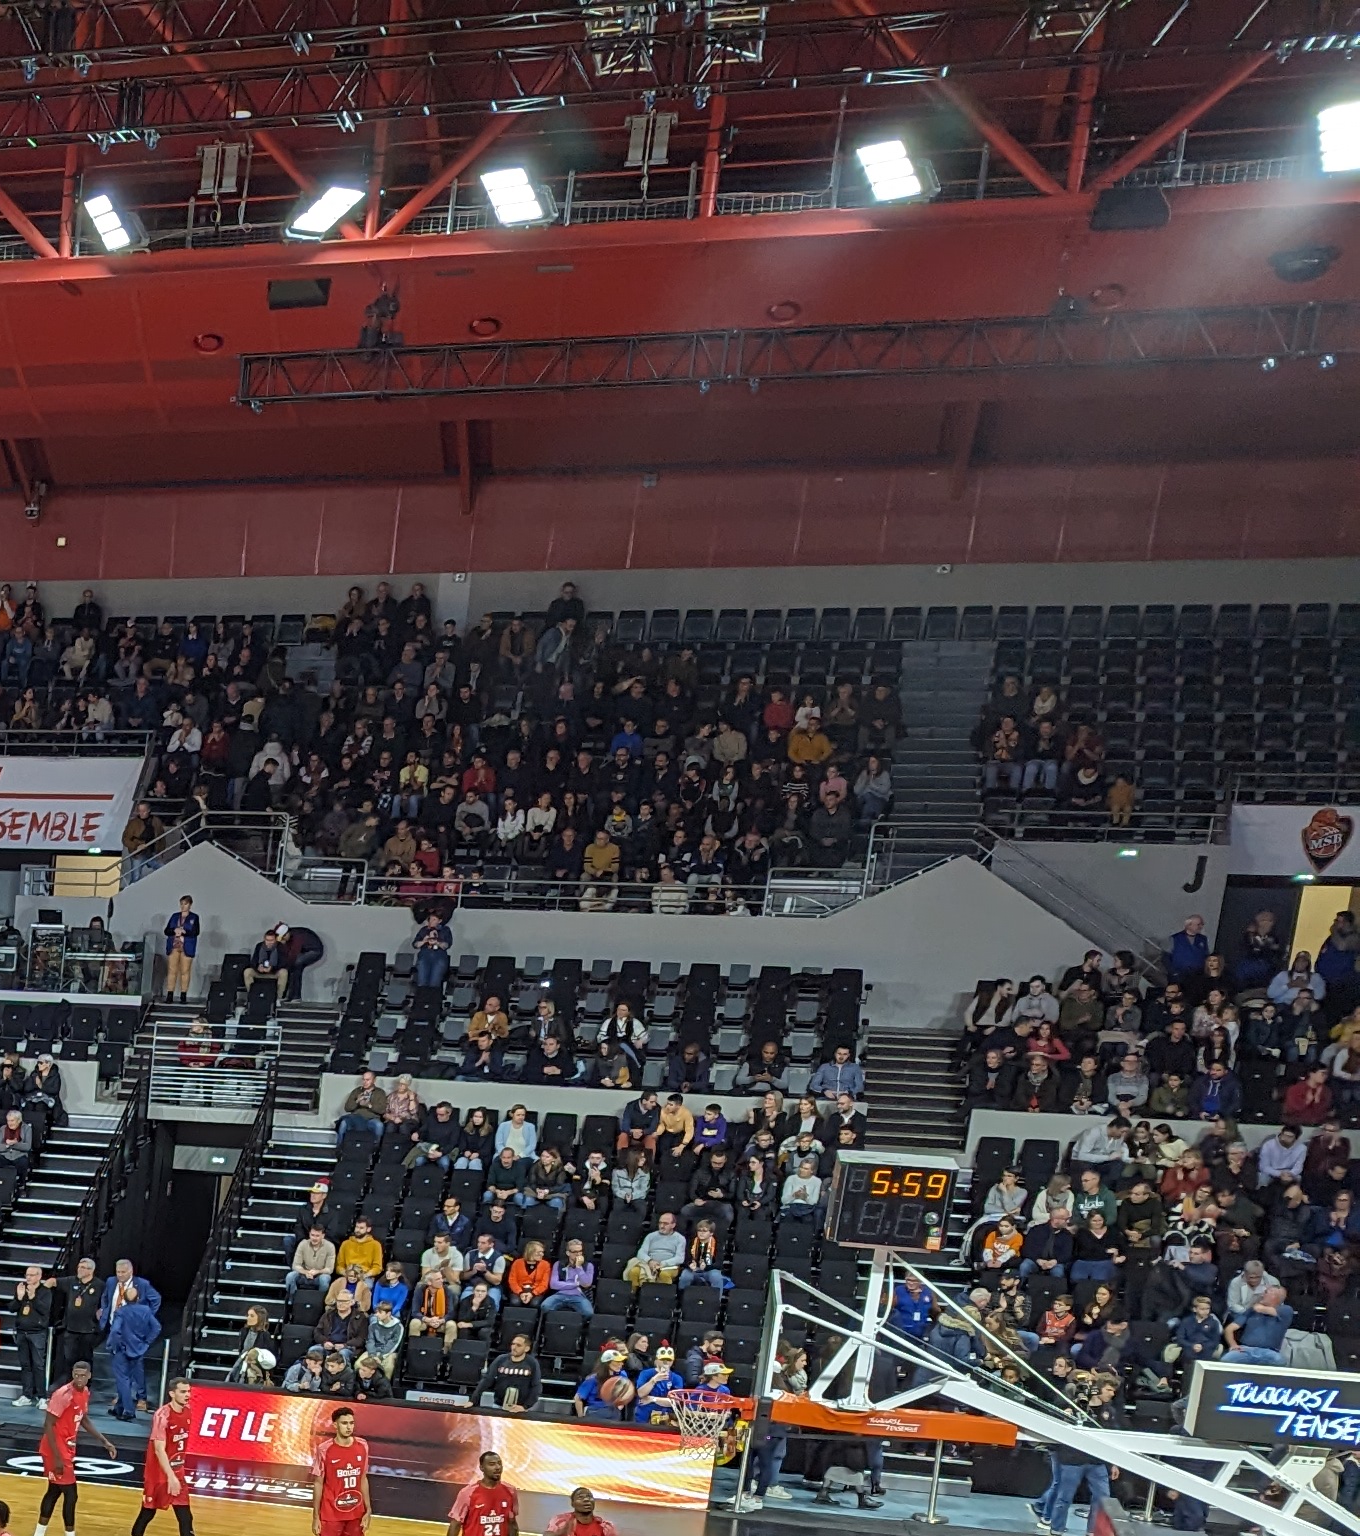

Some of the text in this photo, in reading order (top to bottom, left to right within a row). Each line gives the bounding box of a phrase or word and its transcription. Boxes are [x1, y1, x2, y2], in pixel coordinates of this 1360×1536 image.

[1309, 833, 1342, 850] MSB
[1182, 855, 1208, 893] J
[871, 1170, 947, 1198] 5:59
[199, 1407, 274, 1444] ET LE
[1293, 1415, 1360, 1445] ENSE
[177, 1441, 184, 1451] 3
[343, 1475, 358, 1490] 10
[483, 1524, 501, 1536] 24
